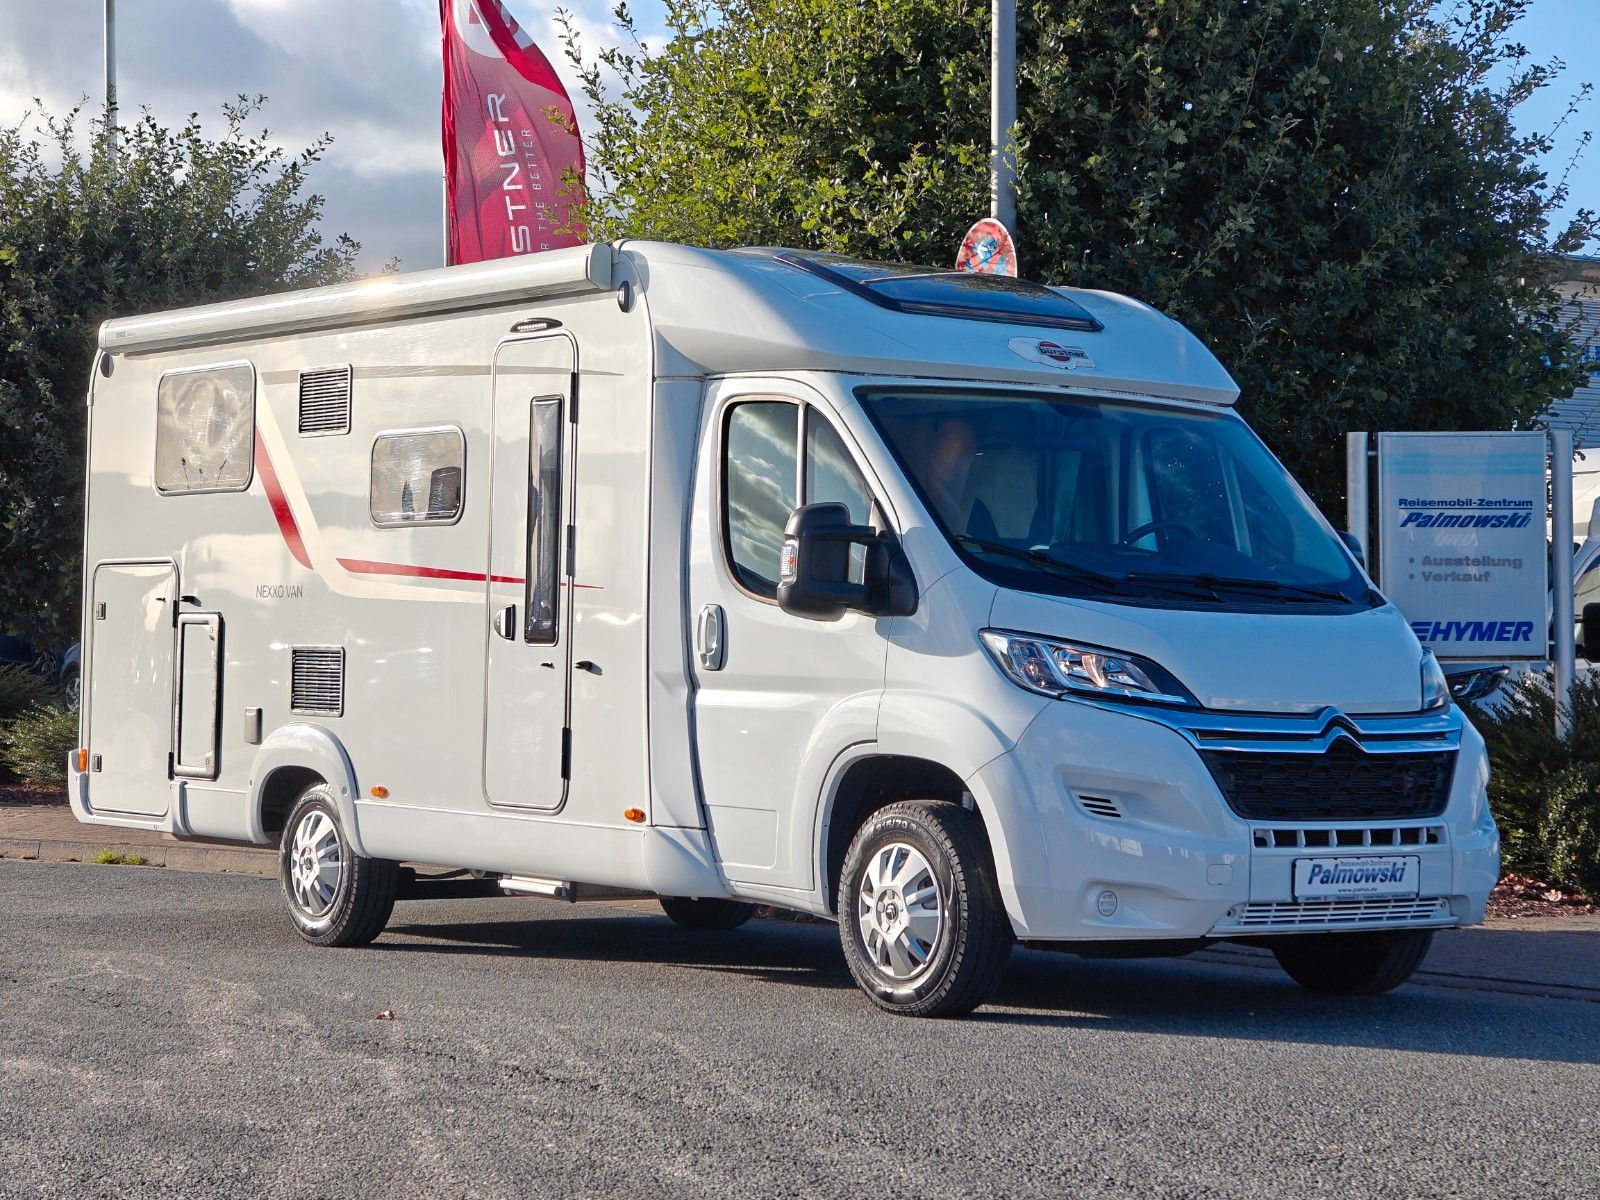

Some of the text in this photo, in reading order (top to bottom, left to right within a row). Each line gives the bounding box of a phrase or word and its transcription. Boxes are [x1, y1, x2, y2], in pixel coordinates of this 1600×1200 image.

[522, 129, 542, 190] BETTER
[535, 202, 548, 231] THE
[1398, 498, 1533, 508] Reisemobil-Zentrum
[1400, 512, 1531, 528] Palmowski
[1421, 555, 1523, 569] Ausstellung
[1421, 571, 1490, 582] Verkauf
[256, 585, 303, 598] NEXXO VAN
[1307, 862, 1407, 885] Palmowski
